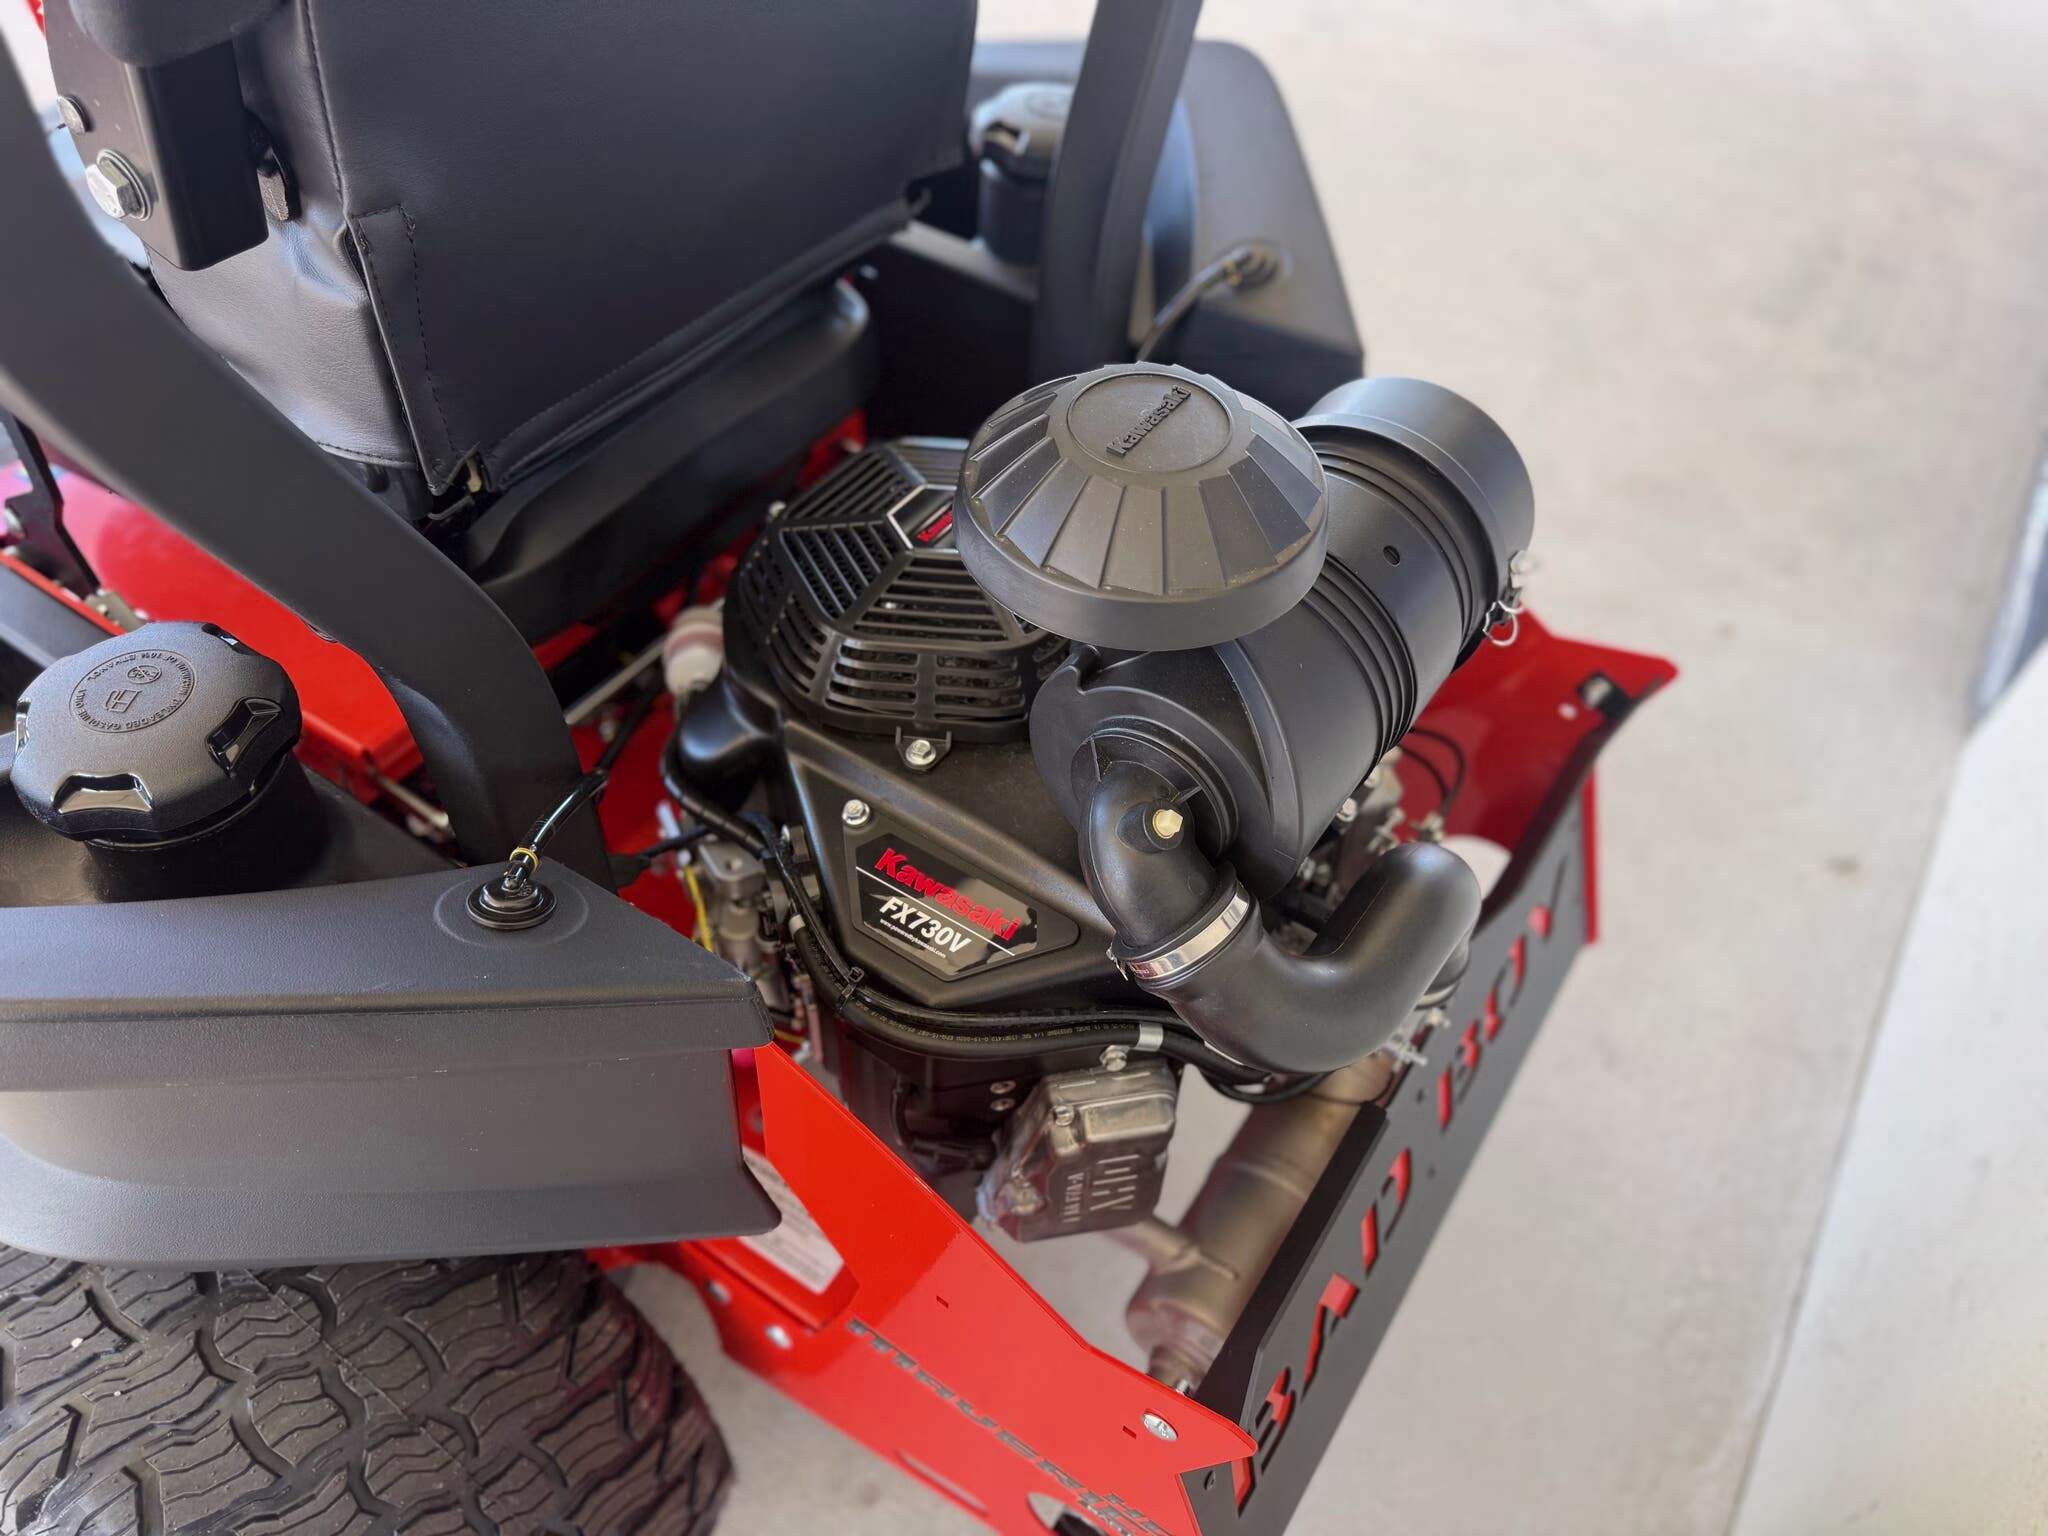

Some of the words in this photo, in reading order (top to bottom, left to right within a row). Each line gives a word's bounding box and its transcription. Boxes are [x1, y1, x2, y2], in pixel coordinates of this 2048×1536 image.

[1106, 384, 1192, 458] Kawasaki
[874, 847, 1023, 941] Kawasaki
[879, 896, 972, 953] FX730V
[1231, 1147, 1411, 1519] BAD
[1437, 855, 1568, 1134] BOY
